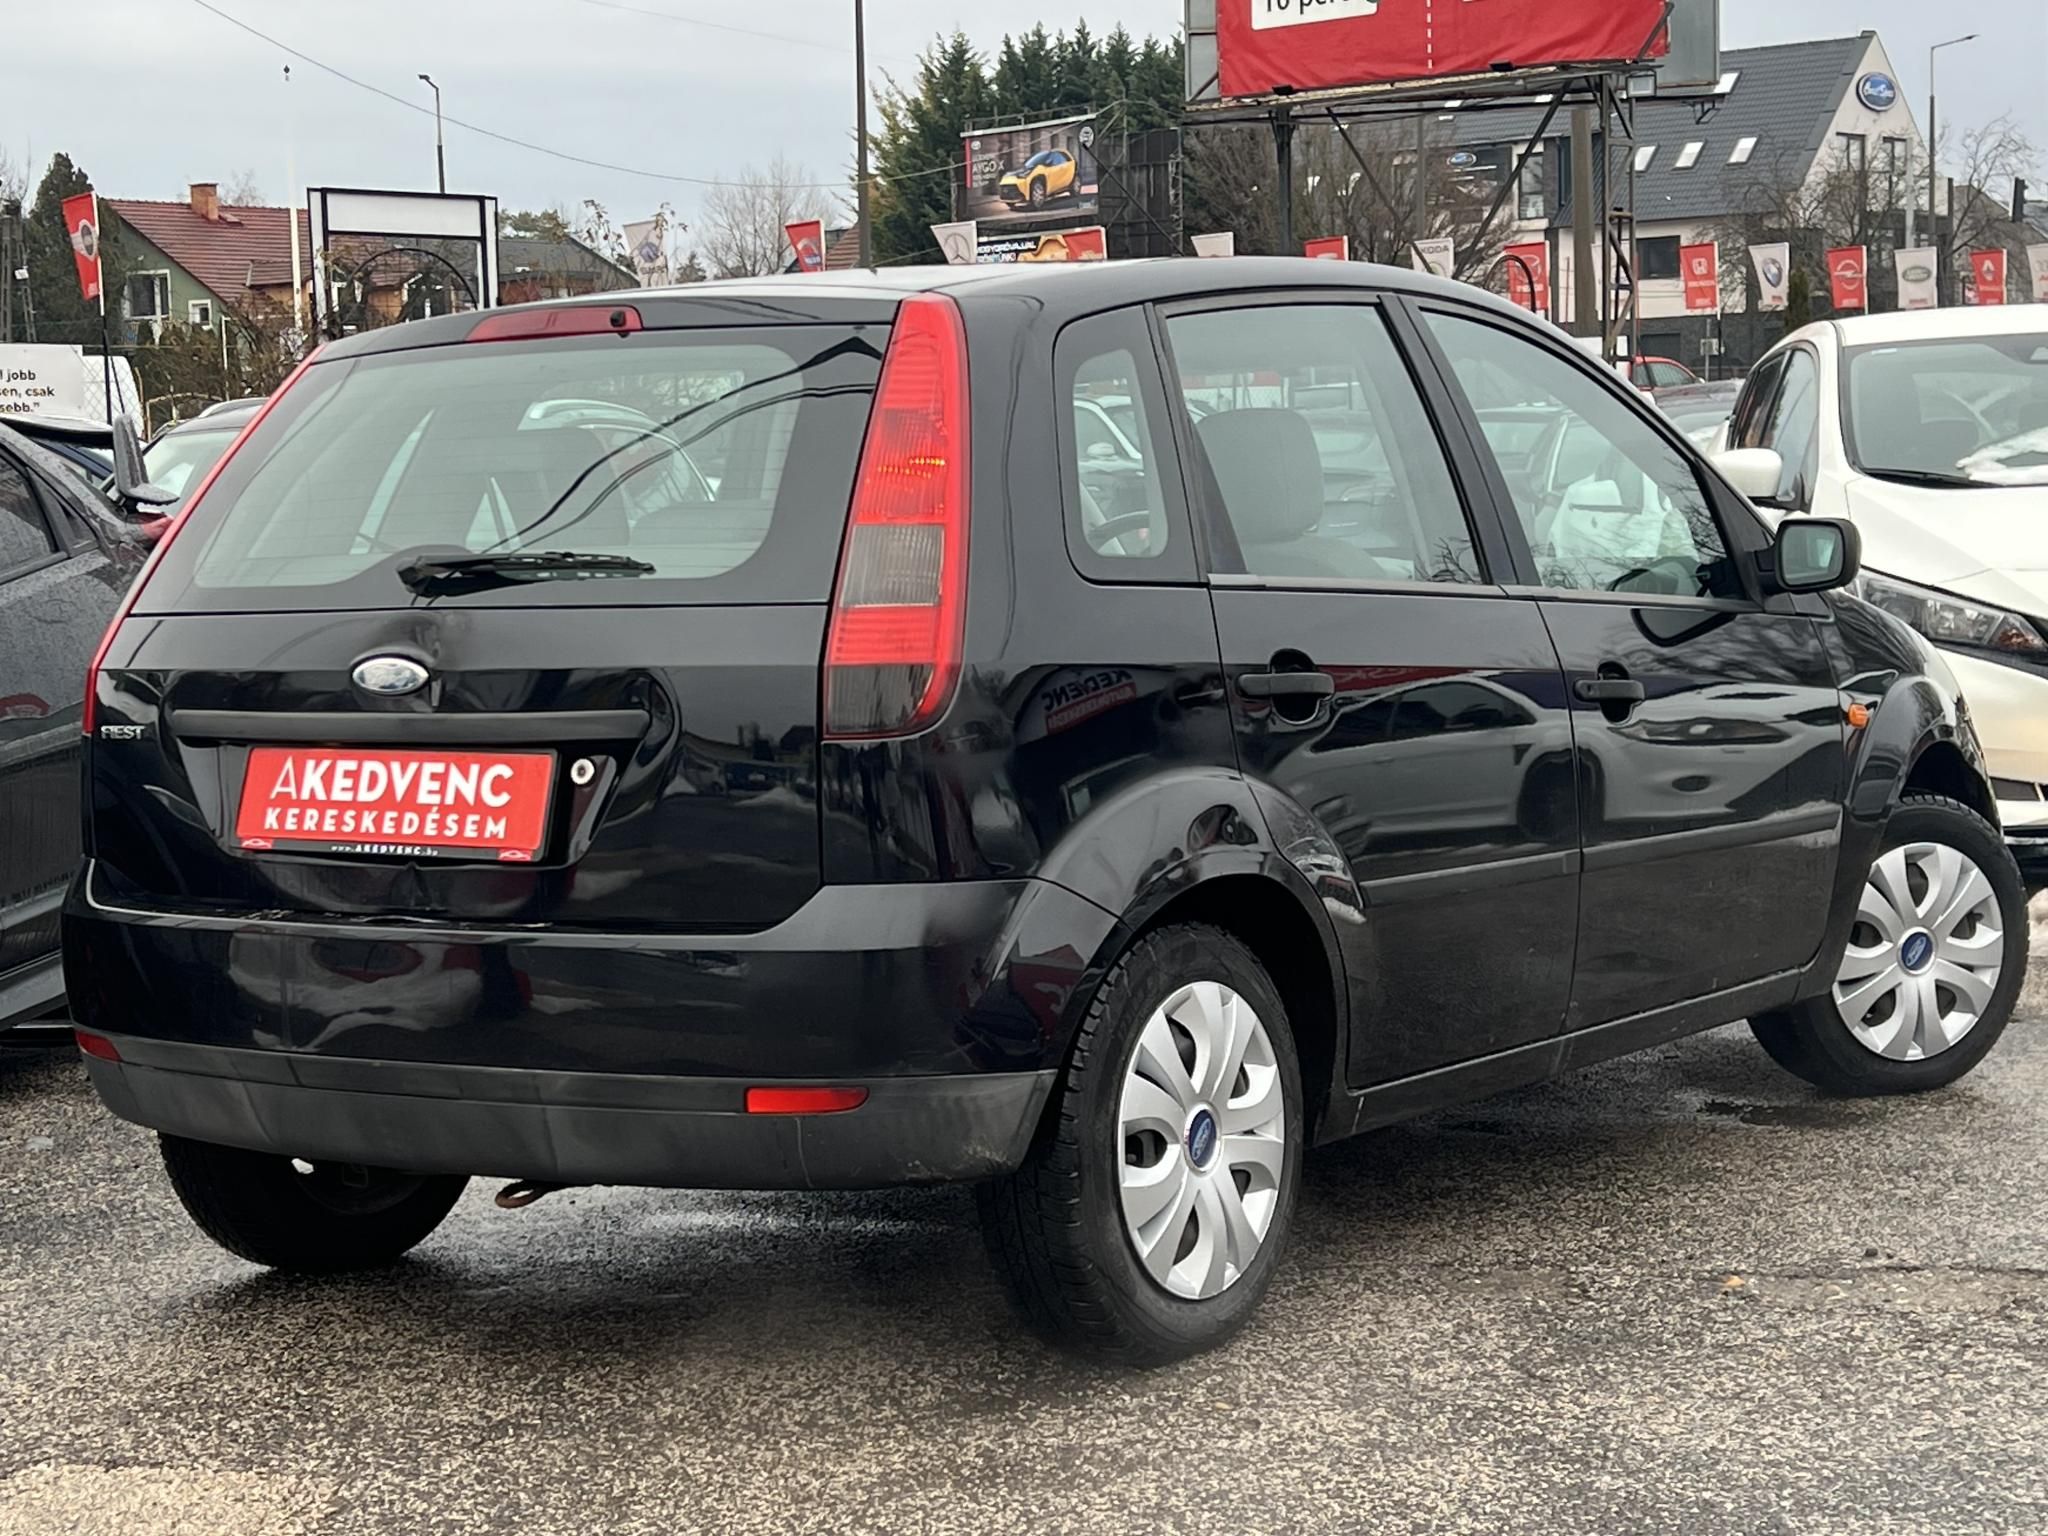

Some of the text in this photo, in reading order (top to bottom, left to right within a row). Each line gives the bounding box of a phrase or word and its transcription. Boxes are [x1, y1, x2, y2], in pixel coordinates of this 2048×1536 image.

[6, 368, 36, 383] jobb
[0, 385, 55, 398] en, csak
[269, 755, 514, 808] AKEDVENC
[263, 805, 508, 840] KERESKEDÉSEM
